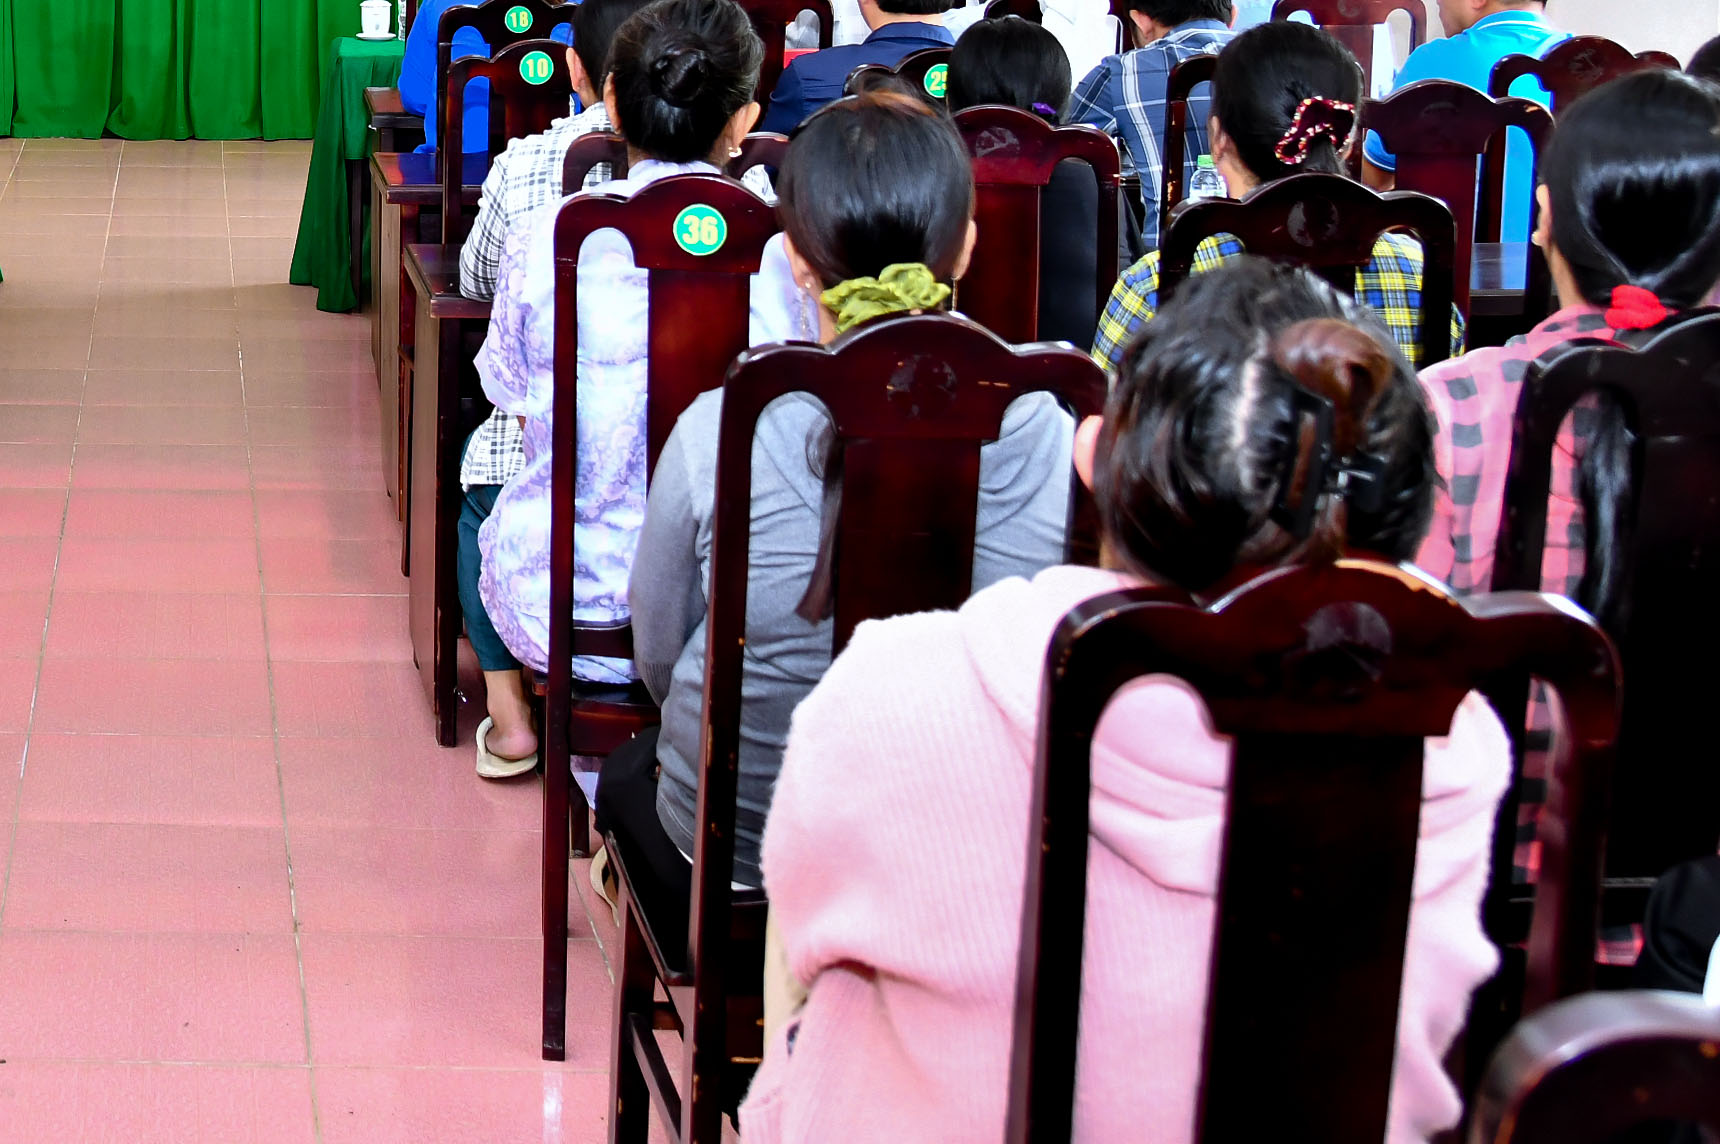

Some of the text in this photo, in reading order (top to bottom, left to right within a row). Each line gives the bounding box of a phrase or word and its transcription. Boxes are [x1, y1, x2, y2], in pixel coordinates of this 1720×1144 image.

[510, 12, 530, 29] 18
[526, 58, 549, 78] 10
[683, 215, 719, 246] 36
